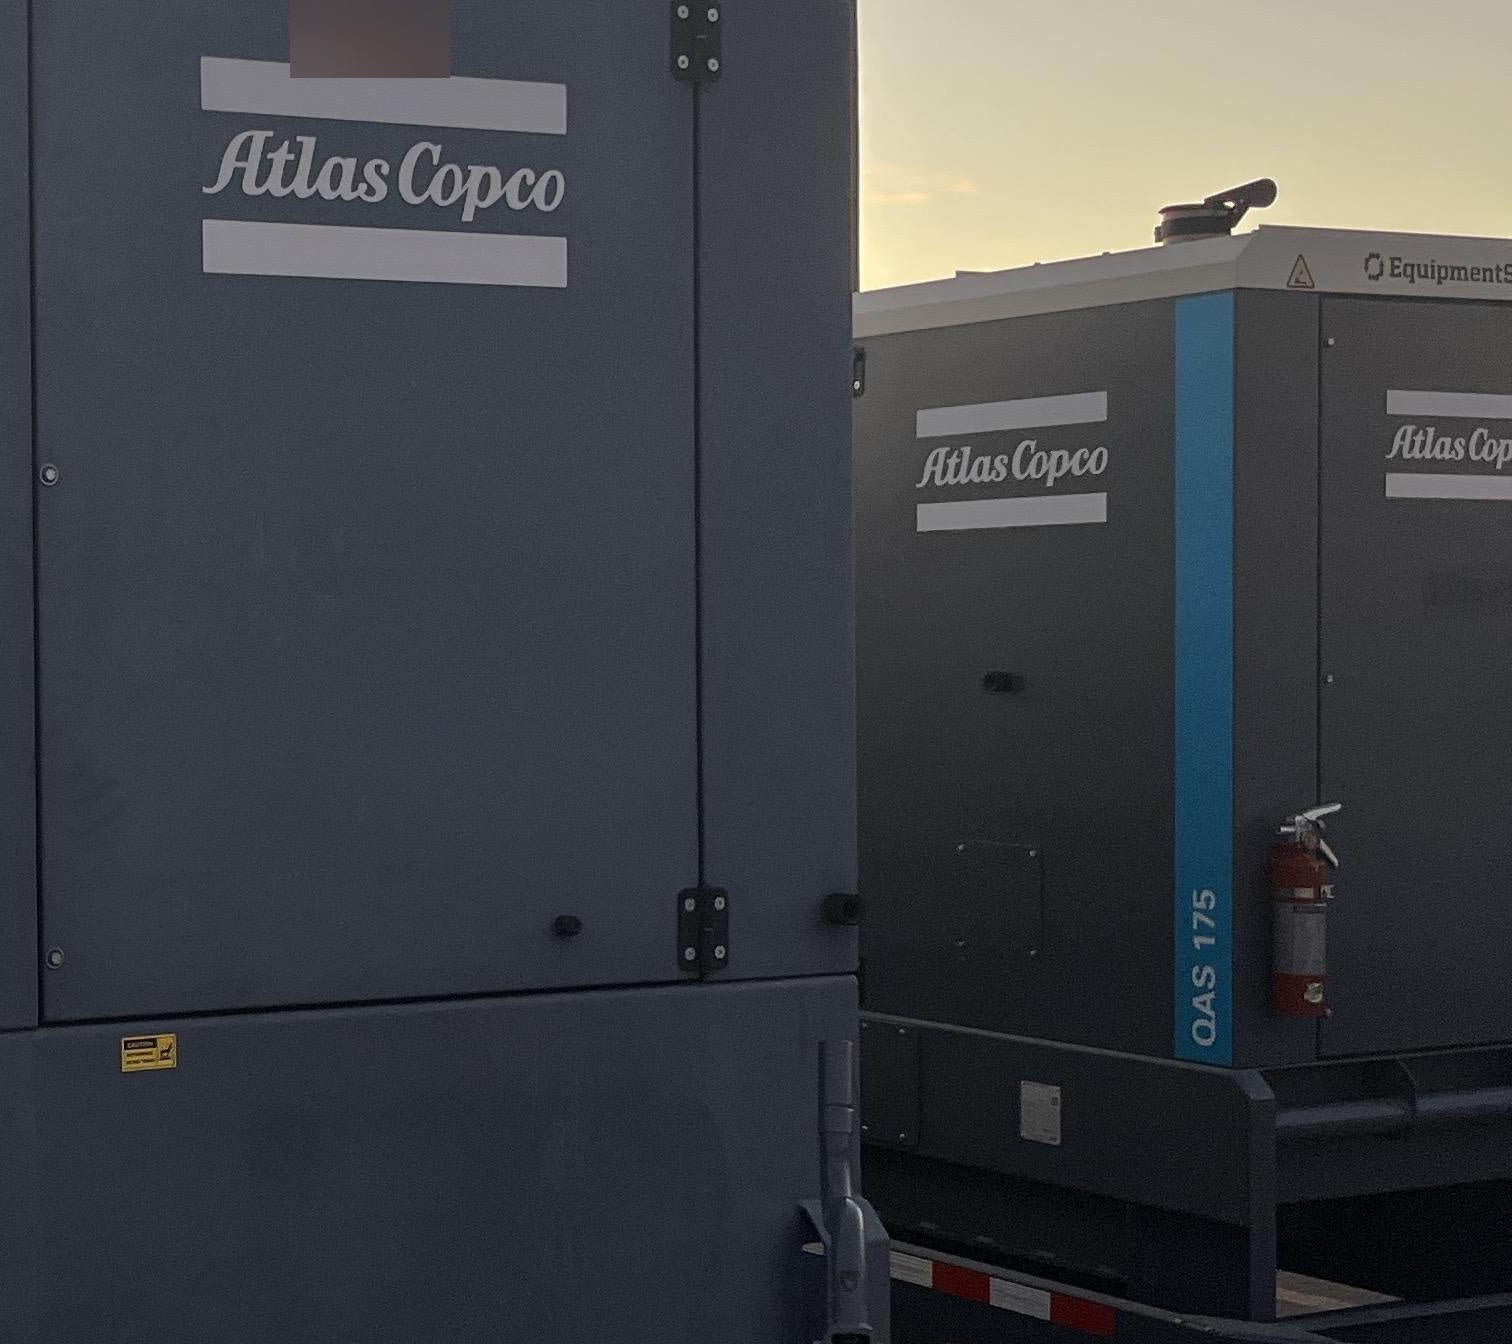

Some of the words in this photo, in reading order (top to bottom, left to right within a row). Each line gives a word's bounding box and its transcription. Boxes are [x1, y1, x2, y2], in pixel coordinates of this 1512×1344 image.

[202, 129, 390, 203] Atlas
[397, 141, 566, 223] Copco
[915, 445, 1009, 488] Atlas
[1011, 439, 1109, 487] Copco
[1384, 424, 1466, 461] Atlas
[1191, 888, 1217, 951] 175
[1191, 964, 1217, 1047] QAS
